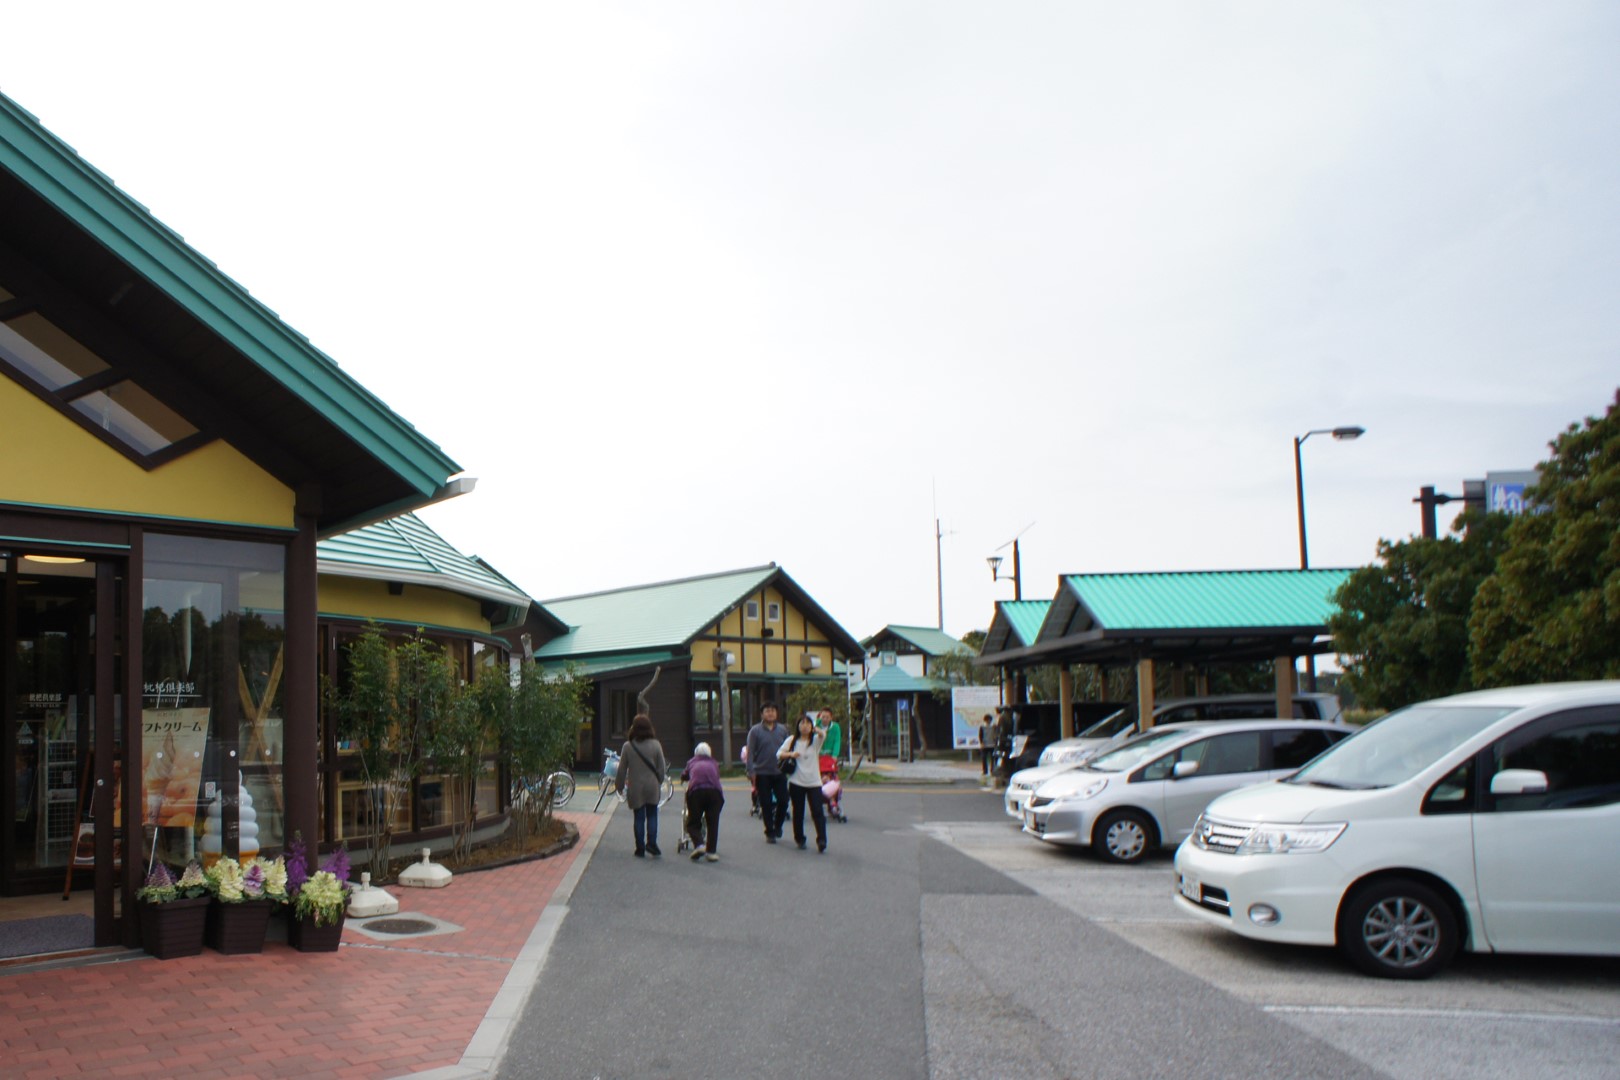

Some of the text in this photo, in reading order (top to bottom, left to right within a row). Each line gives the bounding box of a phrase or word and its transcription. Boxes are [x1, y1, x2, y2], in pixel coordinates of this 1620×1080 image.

[141, 721, 202, 733] フトクリーム
